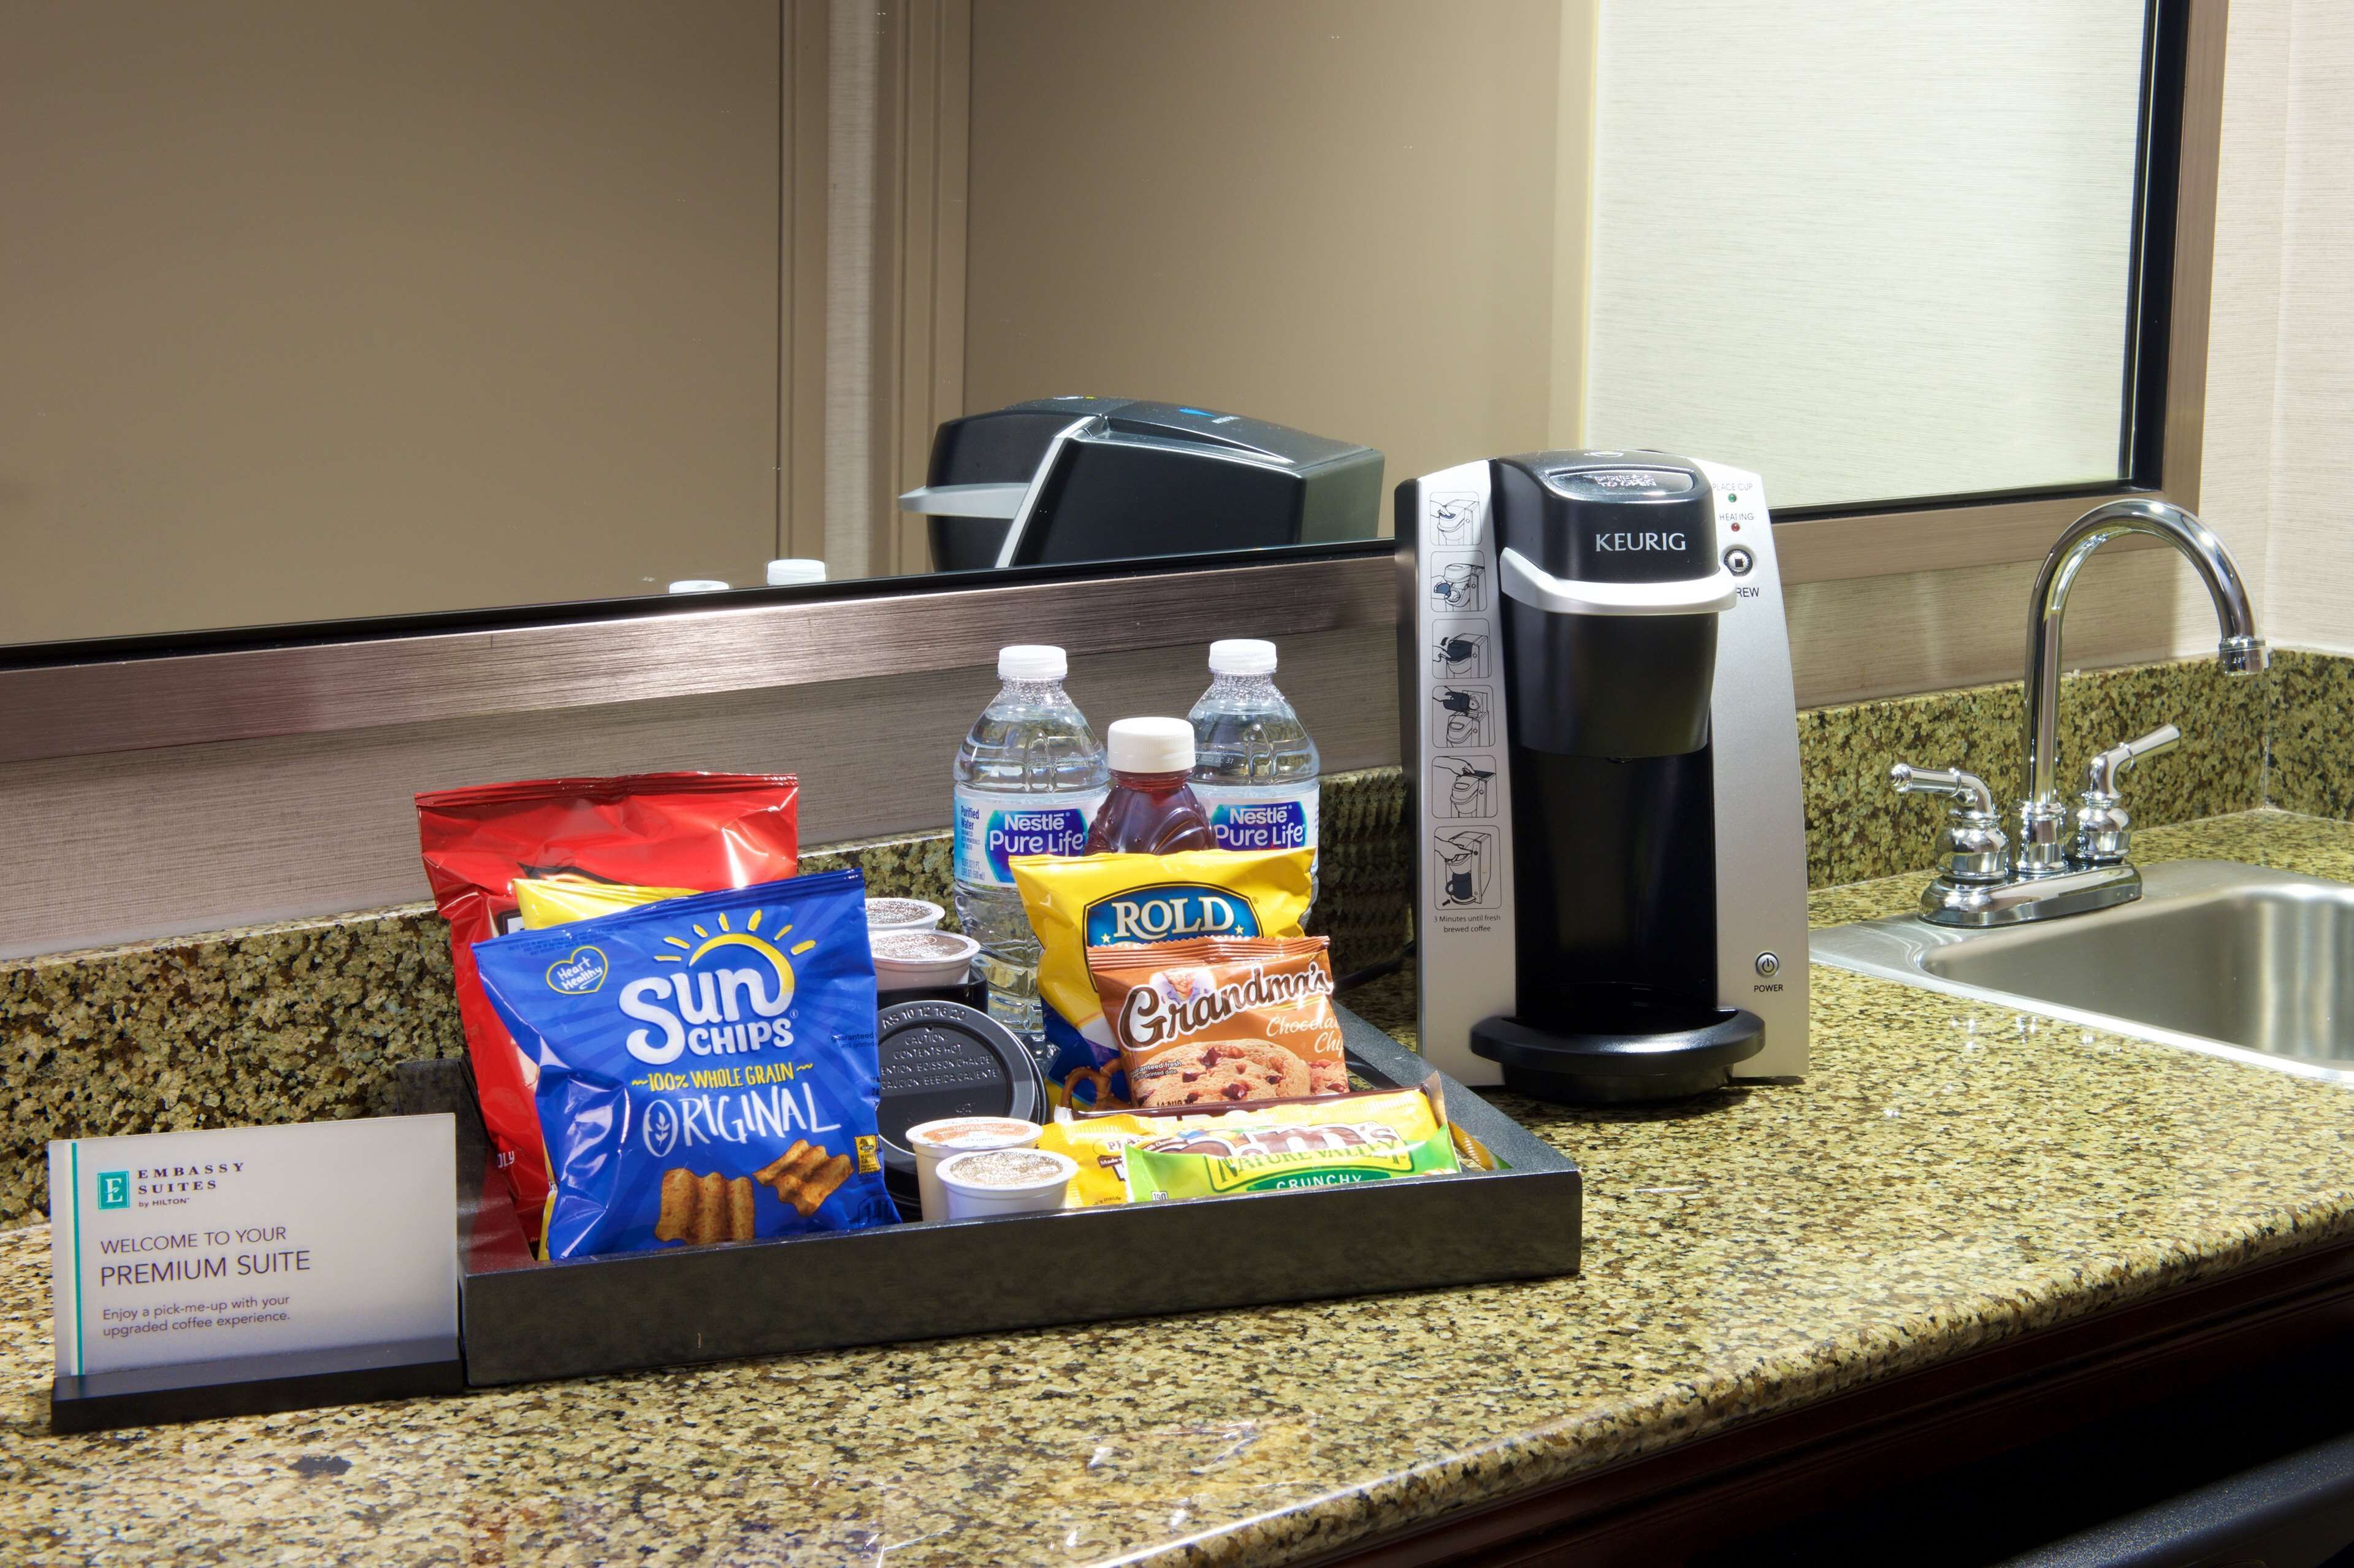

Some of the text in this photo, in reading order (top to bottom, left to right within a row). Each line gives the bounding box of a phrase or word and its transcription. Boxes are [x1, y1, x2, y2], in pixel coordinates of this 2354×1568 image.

[1595, 532, 1687, 552] KEURIG
[1735, 587, 1759, 597] REW
[961, 805, 979, 819] Purified
[961, 817, 974, 830] Water
[989, 830, 1084, 857] Pure Life
[1213, 824, 1269, 846] Pure
[1272, 822, 1303, 849] Life
[1110, 896, 1234, 940] ROLD
[557, 957, 590, 981] Heart
[561, 966, 603, 990] Healthy
[1754, 984, 1784, 992] POWER
[619, 968, 795, 1065] Sun
[902, 1009, 914, 1020] 10
[918, 1007, 931, 1017] 12
[1119, 960, 1332, 1049] Grandma's
[687, 1018, 795, 1056] CHIPS
[904, 1033, 948, 1046] CAUTION:
[893, 1044, 961, 1060] CONTENTS HOT
[1165, 1060, 1182, 1068] fresh
[648, 1061, 795, 1092] 100% WHOLE GRAIN
[881, 1065, 914, 1076] ENTION:
[917, 1060, 954, 1072] BOISSON
[881, 1079, 922, 1090] CAUCION:
[923, 1074, 956, 1085] BEBIDA
[643, 1082, 841, 1158] ORIGINAL
[137, 1163, 244, 1179] EMBASSY
[1216, 1149, 1312, 1184] NATURE
[138, 1180, 216, 1195] SUITES
[1275, 1174, 1362, 1190] CRUNCHY
[101, 1226, 287, 1255] WELCOME TO YOUR
[101, 1250, 311, 1287] PREMIUM SUITE
[102, 1296, 290, 1322] Enjoy a pick-me-up with your
[103, 1311, 290, 1339] upgraded coffee experience.
